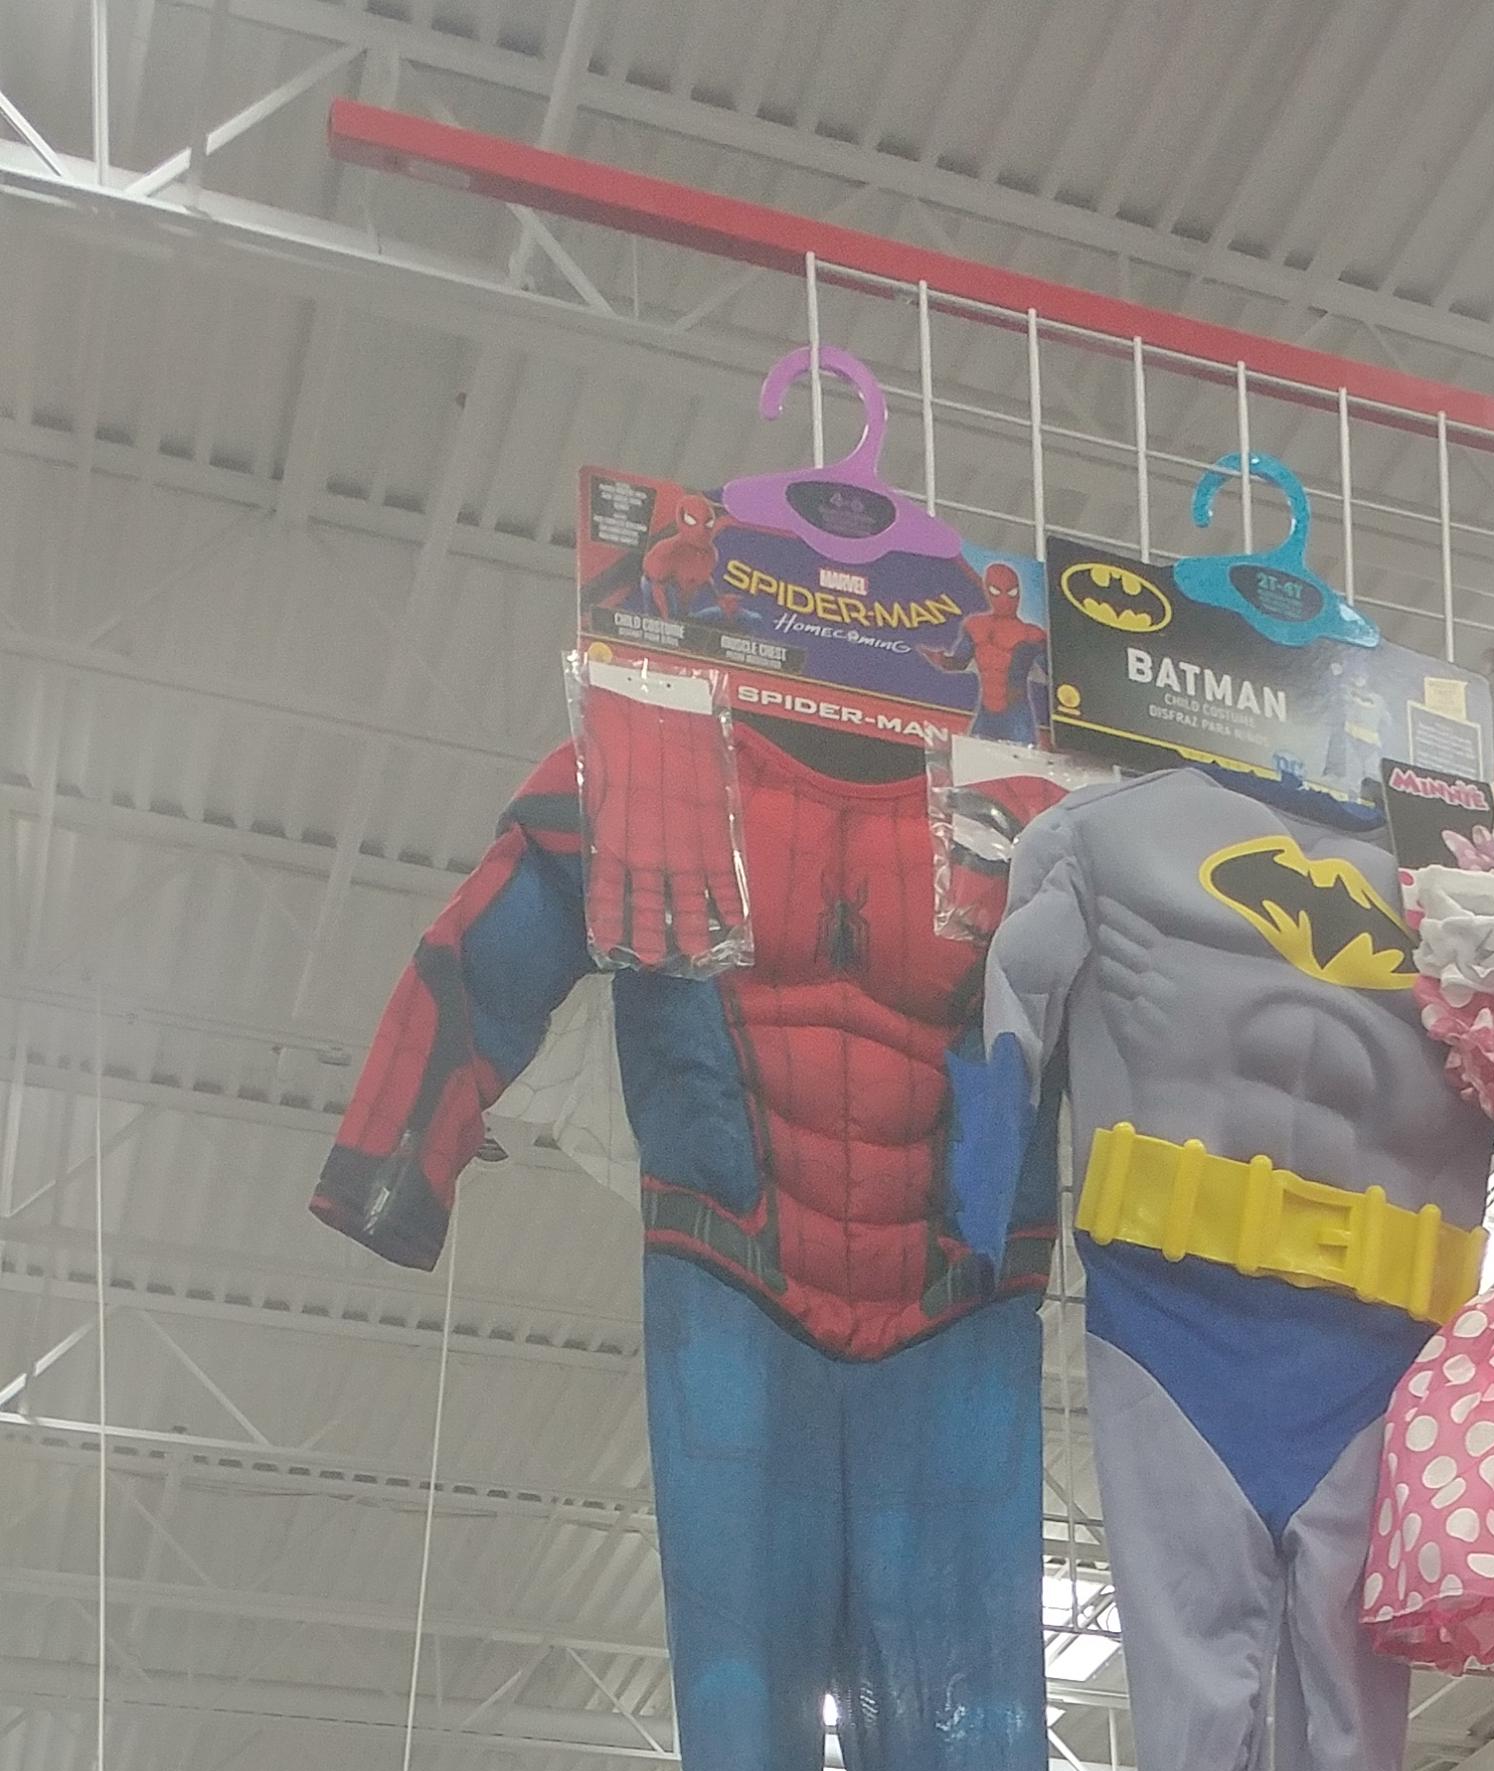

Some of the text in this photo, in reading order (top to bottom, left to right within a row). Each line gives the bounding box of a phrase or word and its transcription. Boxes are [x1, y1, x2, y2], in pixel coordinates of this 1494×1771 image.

[722, 559, 963, 630] SPIDER-MAN
[819, 568, 870, 596] MARVEL
[737, 684, 950, 744] SPIDER-MAN
[1126, 647, 1288, 722] BATMAN
